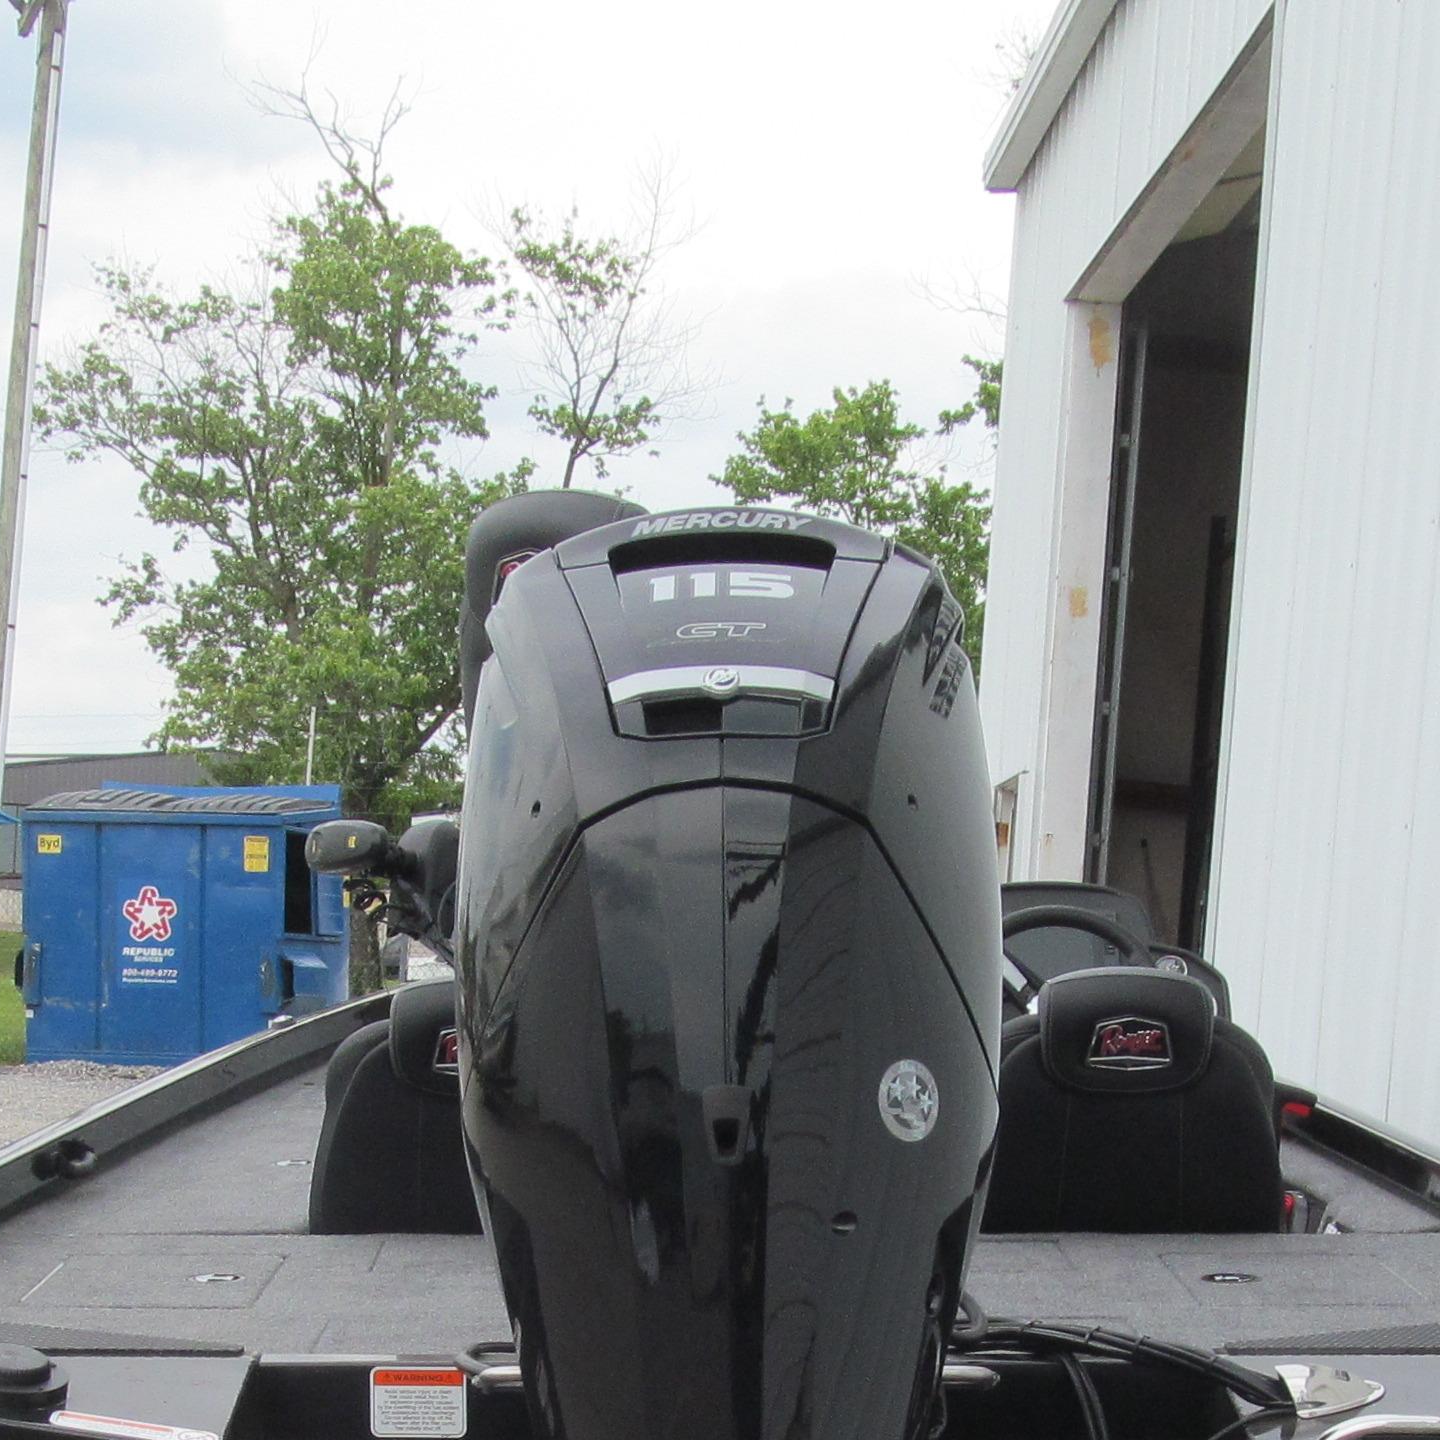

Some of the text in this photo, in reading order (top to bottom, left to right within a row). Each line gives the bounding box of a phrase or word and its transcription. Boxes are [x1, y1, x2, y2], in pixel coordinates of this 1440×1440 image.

[631, 512, 813, 537] MERCURY
[650, 571, 795, 602] 115
[676, 622, 767, 639] GT
[121, 946, 176, 957] REPUBLIC
[392, 1374, 444, 1382] WARNING
